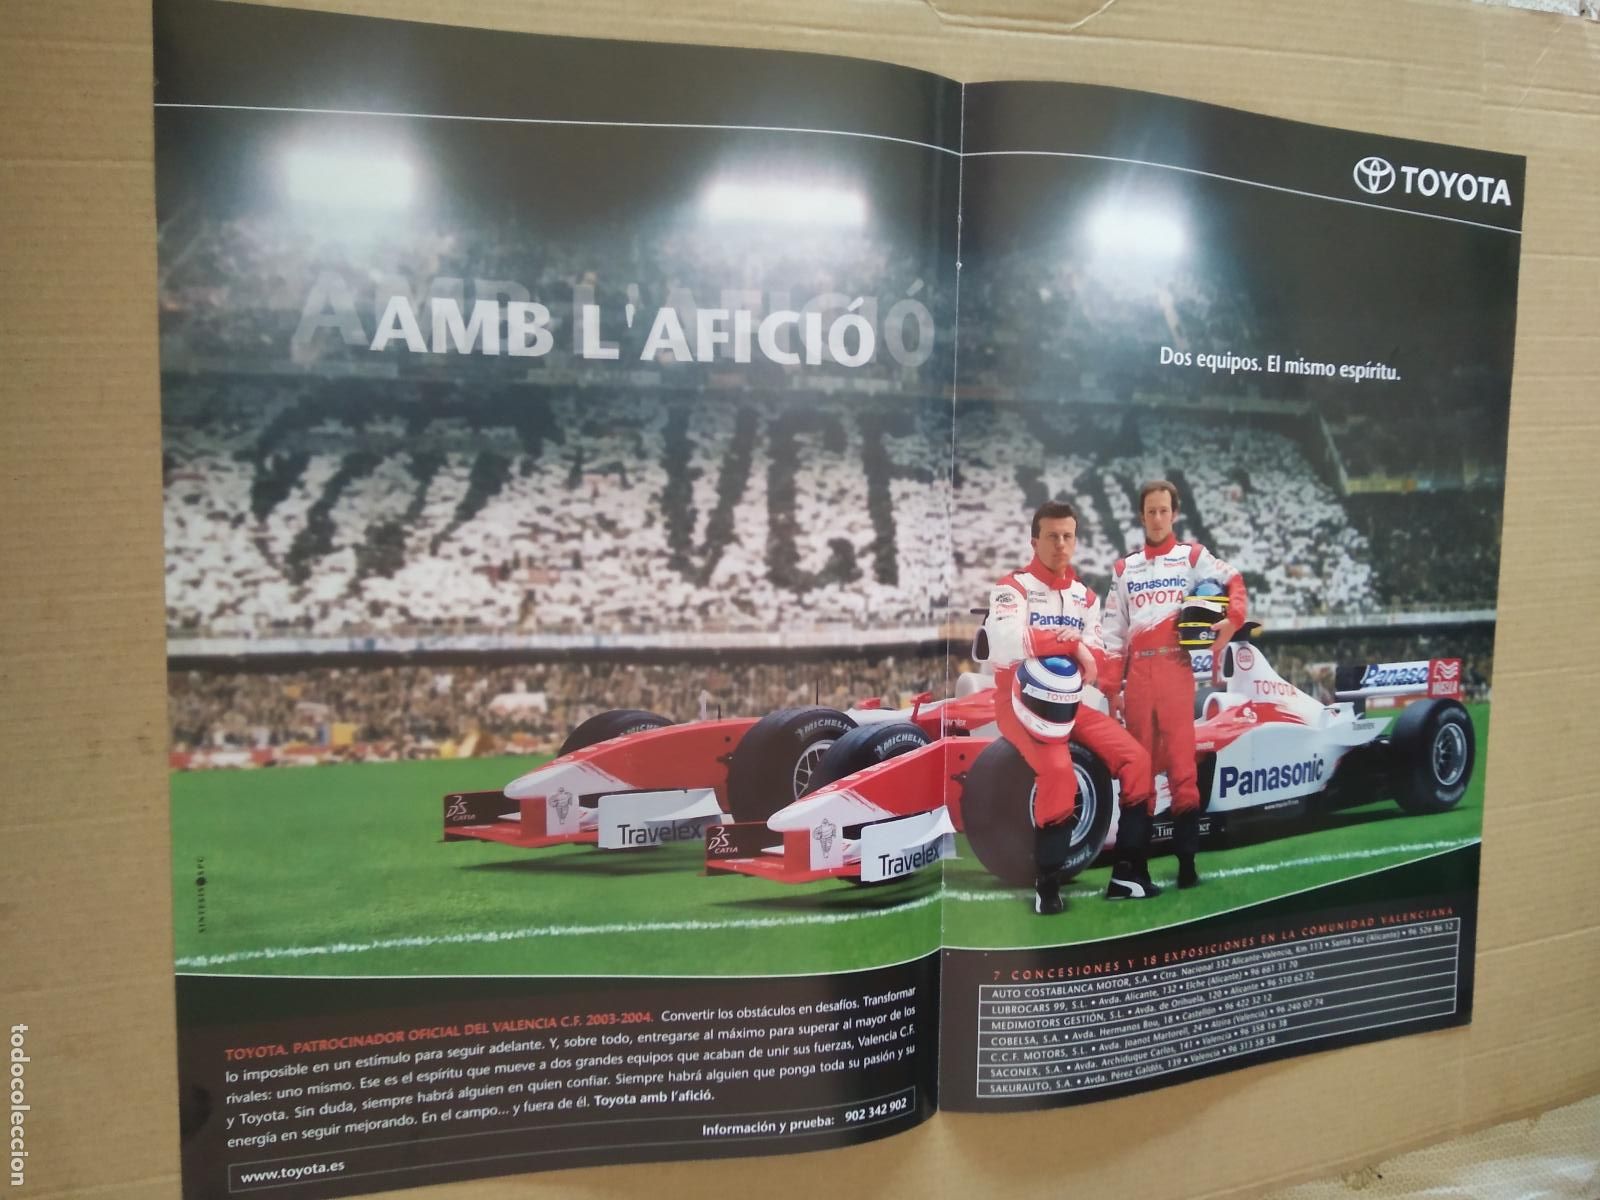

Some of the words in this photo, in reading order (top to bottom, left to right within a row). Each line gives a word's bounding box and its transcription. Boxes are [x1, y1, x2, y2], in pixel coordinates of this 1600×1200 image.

[1401, 166, 1512, 206] TOYOTA
[370, 296, 554, 358] AMB
[582, 297, 876, 367] L'AFICIÓ
[1160, 346, 1192, 367] Dos
[1196, 351, 1263, 373] equipos.
[1267, 355, 1281, 373] El
[1285, 357, 1336, 378] mismo
[1340, 361, 1402, 383] espíritu.
[1127, 575, 1187, 594] Panasonic
[1253, 680, 1298, 696] TOYOTA
[1219, 753, 1324, 798] Panasonic
[616, 820, 703, 845] Travelex
[878, 842, 940, 877] Travelex
[993, 970, 1001, 980] 7
[1010, 961, 1119, 980] CONCESIONES
[1127, 959, 1134, 968] Y
[1143, 955, 1157, 965] 18
[1163, 937, 1254, 962] EXPOSICIONES
[1260, 934, 1275, 943] EN
[1281, 930, 1295, 939] LA
[1300, 917, 1374, 936] COMUNIDAD
[1380, 908, 1453, 924] VALENCIANA
[991, 989, 1021, 998] AUTO
[1023, 983, 1094, 997] COSTABLANCA
[991, 1003, 1050, 1014] LUBROCARS
[224, 1044, 288, 1060] TOYOTA.
[292, 1030, 404, 1053] PATROCINADOR
[407, 1025, 461, 1040] OFICIAL
[463, 1023, 489, 1035] DEL
[492, 1017, 557, 1032] VALENCIA
[559, 1015, 582, 1027] C.F.
[585, 1011, 653, 1025] 2003-2004.
[660, 1008, 715, 1021] Convertir
[717, 1008, 733, 1019] los
[736, 1004, 795, 1018] obstáculos
[798, 1005, 812, 1014] en
[814, 998, 859, 1013] desafíos.
[862, 987, 916, 1006] Transformar
[990, 1018, 1060, 1030] MEDIMOTORS
[225, 1071, 239, 1082] lo
[242, 1063, 309, 1082] imposible
[311, 1063, 329, 1072] en
[333, 1060, 351, 1070] un
[354, 1051, 411, 1068] estímulo
[414, 1050, 443, 1064] para
[446, 1043, 485, 1059] seguir
[488, 1040, 545, 1053] adelante.
[548, 1037, 559, 1049] Y,
[563, 1035, 597, 1047] sobre
[600, 1032, 633, 1044] todo,
[636, 1031, 700, 1044] entregarse
[703, 1028, 713, 1040] al
[717, 1027, 765, 1039] máximo
[768, 1026, 794, 1039] para
[797, 1022, 840, 1036] superar
[842, 1017, 852, 1030] al
[854, 1014, 888, 1028] mayor
[889, 1009, 901, 1021] de
[903, 1006, 916, 1017] los
[226, 1090, 271, 1104] rivales:
[276, 1087, 303, 1099] uno
[307, 1081, 354, 1095] mismo.
[359, 1077, 380, 1088] Ese
[384, 1075, 398, 1085] es
[401, 1071, 412, 1084] el
[416, 1067, 462, 1083] espíritu
[466, 1066, 490, 1079] que
[494, 1062, 535, 1073] mueve
[538, 1061, 546, 1069] a
[550, 1057, 571, 1068] dos
[575, 1053, 623, 1070] grandes
[626, 1052, 673, 1066] equipos
[676, 1052, 699, 1064] que
[702, 1048, 744, 1060] acaban
[748, 1046, 763, 1058] de
[766, 1045, 789, 1057] unir
[793, 1045, 810, 1055] sus
[813, 1040, 854, 1053] fuerzas,
[857, 1030, 897, 1046] Valencia
[899, 1023, 914, 1037] C.F.
[226, 1117, 234, 1129] y
[239, 1110, 288, 1126] Toyota.
[294, 1105, 314, 1118] Sin
[318, 1100, 356, 1115] duda,
[361, 1095, 413, 1109] siempre
[417, 1087, 453, 1102] habrá
[457, 1084, 503, 1100] alguien
[507, 1083, 523, 1093] en
[527, 1079, 562, 1093] quien
[566, 1075, 610, 1088] confiar.
[615, 1073, 663, 1086] Siempre
[668, 1069, 701, 1081] habrá
[705, 1068, 748, 1082] alguien
[753, 1068, 775, 1080] que
[779, 1064, 815, 1078] ponga
[819, 1059, 844, 1072] toda
[848, 1058, 859, 1068] su
[863, 1049, 895, 1068] pasión
[897, 1048, 903, 1060] y
[905, 1044, 915, 1055] su
[227, 1131, 276, 1147] energía
[280, 1131, 297, 1141] en
[301, 1123, 340, 1140] seguir
[344, 1114, 417, 1133] mejorando.
[421, 1111, 437, 1123] En
[440, 1108, 451, 1121] el
[512, 1104, 520, 1116] y
[523, 1100, 554, 1112] fuera
[557, 1097, 572, 1109] de
[576, 1095, 589, 1107] él.
[593, 1094, 636, 1108] Toyota
[639, 1091, 667, 1103] amb
[702, 1120, 775, 1135] Información
[779, 1122, 786, 1134] y
[789, 1115, 834, 1132] prueba:
[844, 1108, 865, 1121] 902
[868, 1103, 887, 1118] 342
[889, 1097, 906, 1112] 902
[241, 1161, 344, 1183] www.toyota.es
